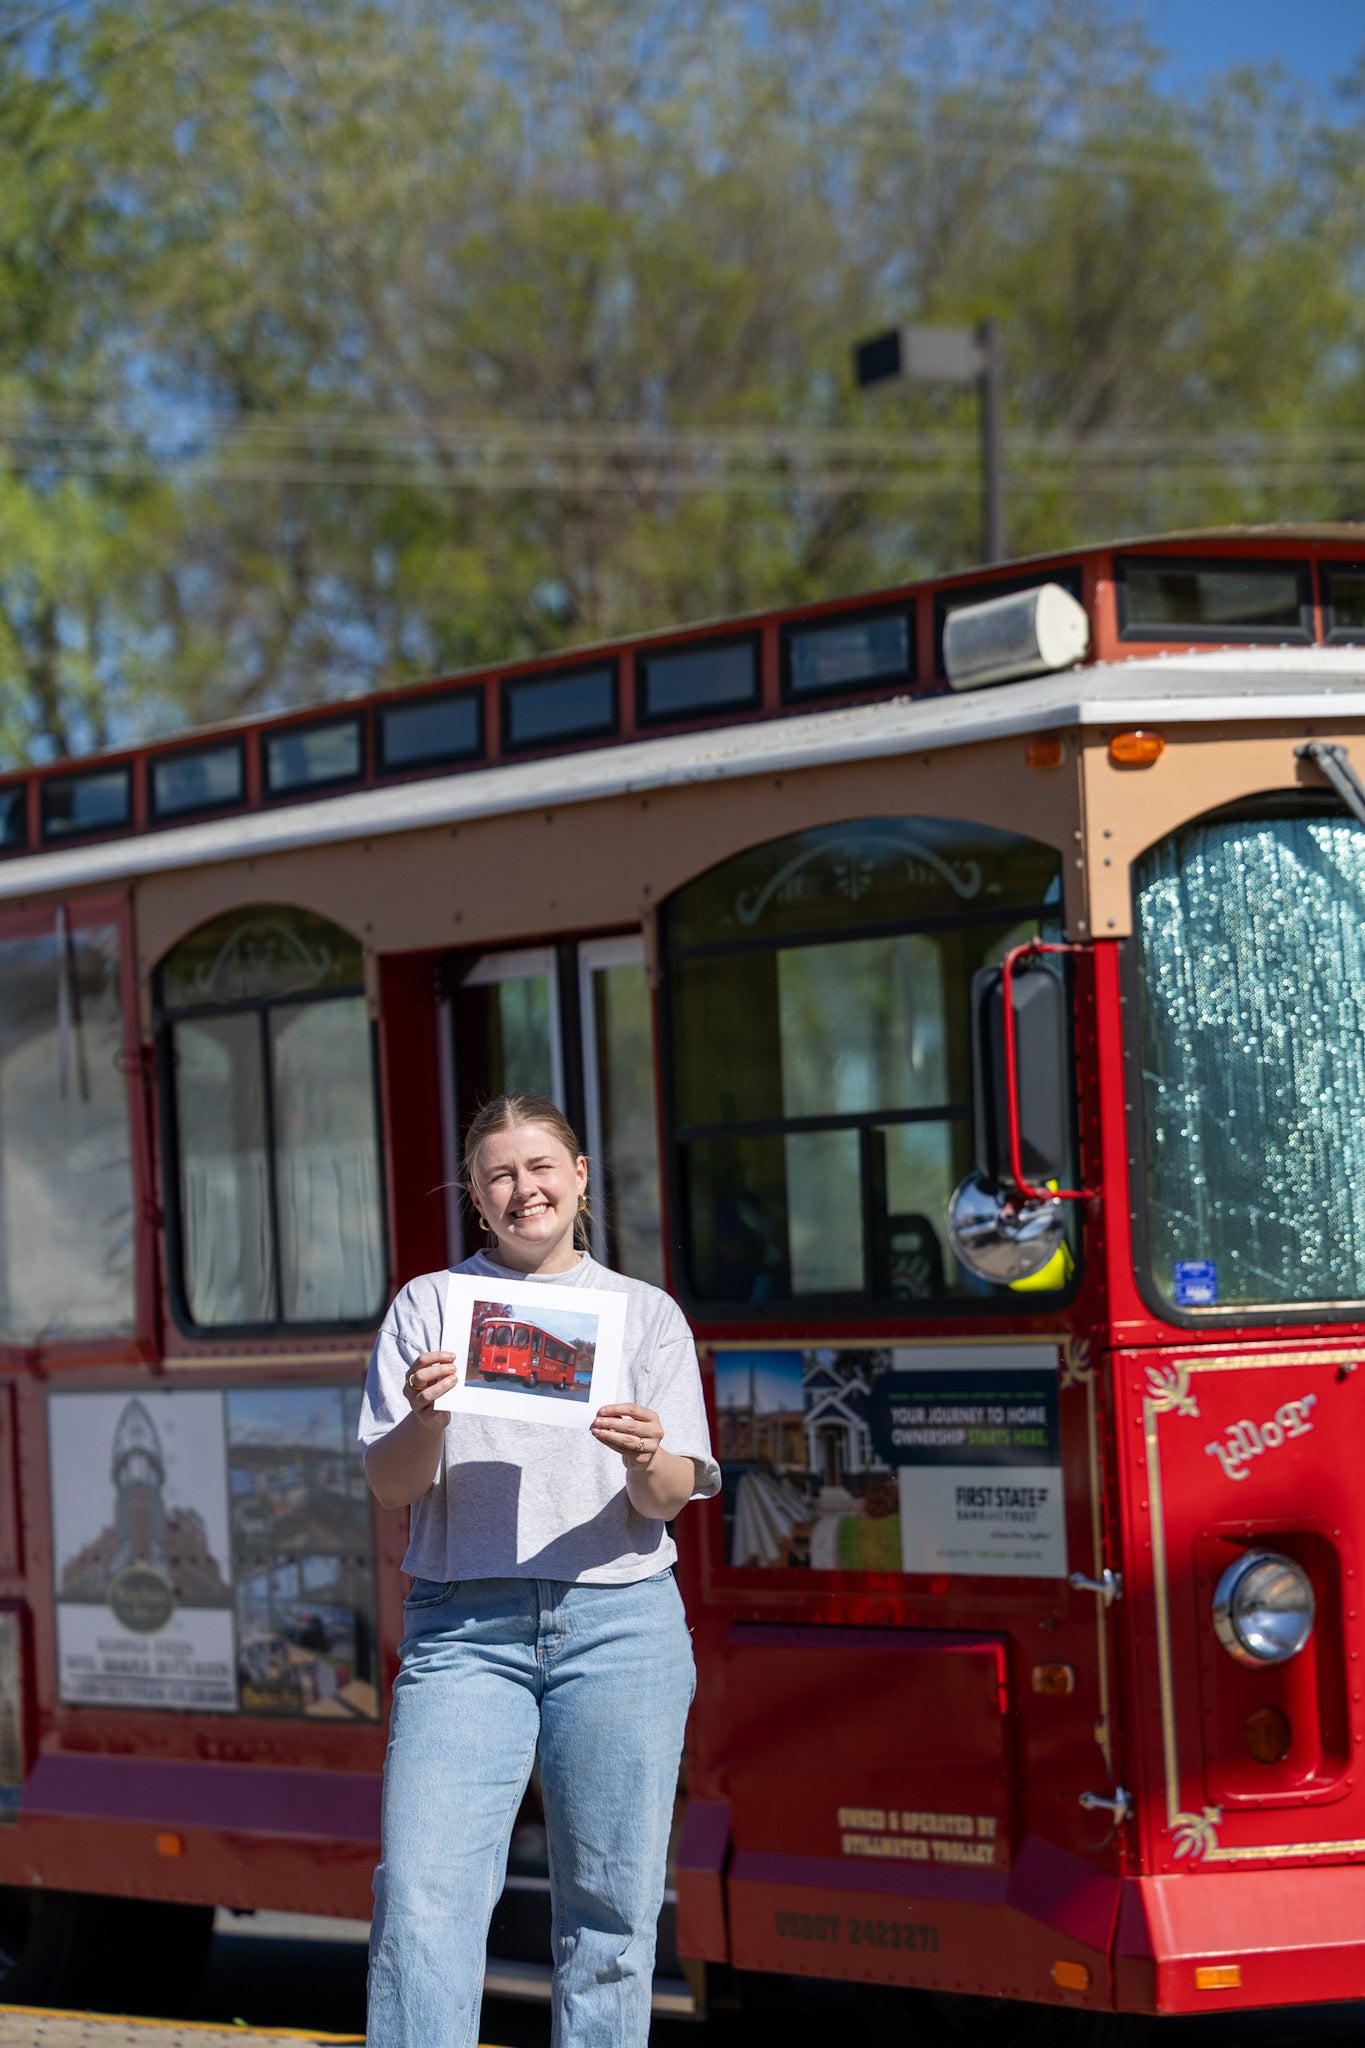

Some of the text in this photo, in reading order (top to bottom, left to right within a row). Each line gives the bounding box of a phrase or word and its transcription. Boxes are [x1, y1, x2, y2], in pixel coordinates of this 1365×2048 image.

[890, 1407, 1046, 1424] YOUR JOURNEY TO HOME
[892, 1429, 965, 1446] OWNERSHIP
[956, 1487, 1037, 1508] FIRST STATE
[838, 1808, 885, 1830] OWNED
[902, 1812, 975, 1836] OPERATED
[977, 1817, 997, 1838] BY
[932, 1841, 996, 1865] TROLLEY
[775, 1911, 840, 1942] USDOT
